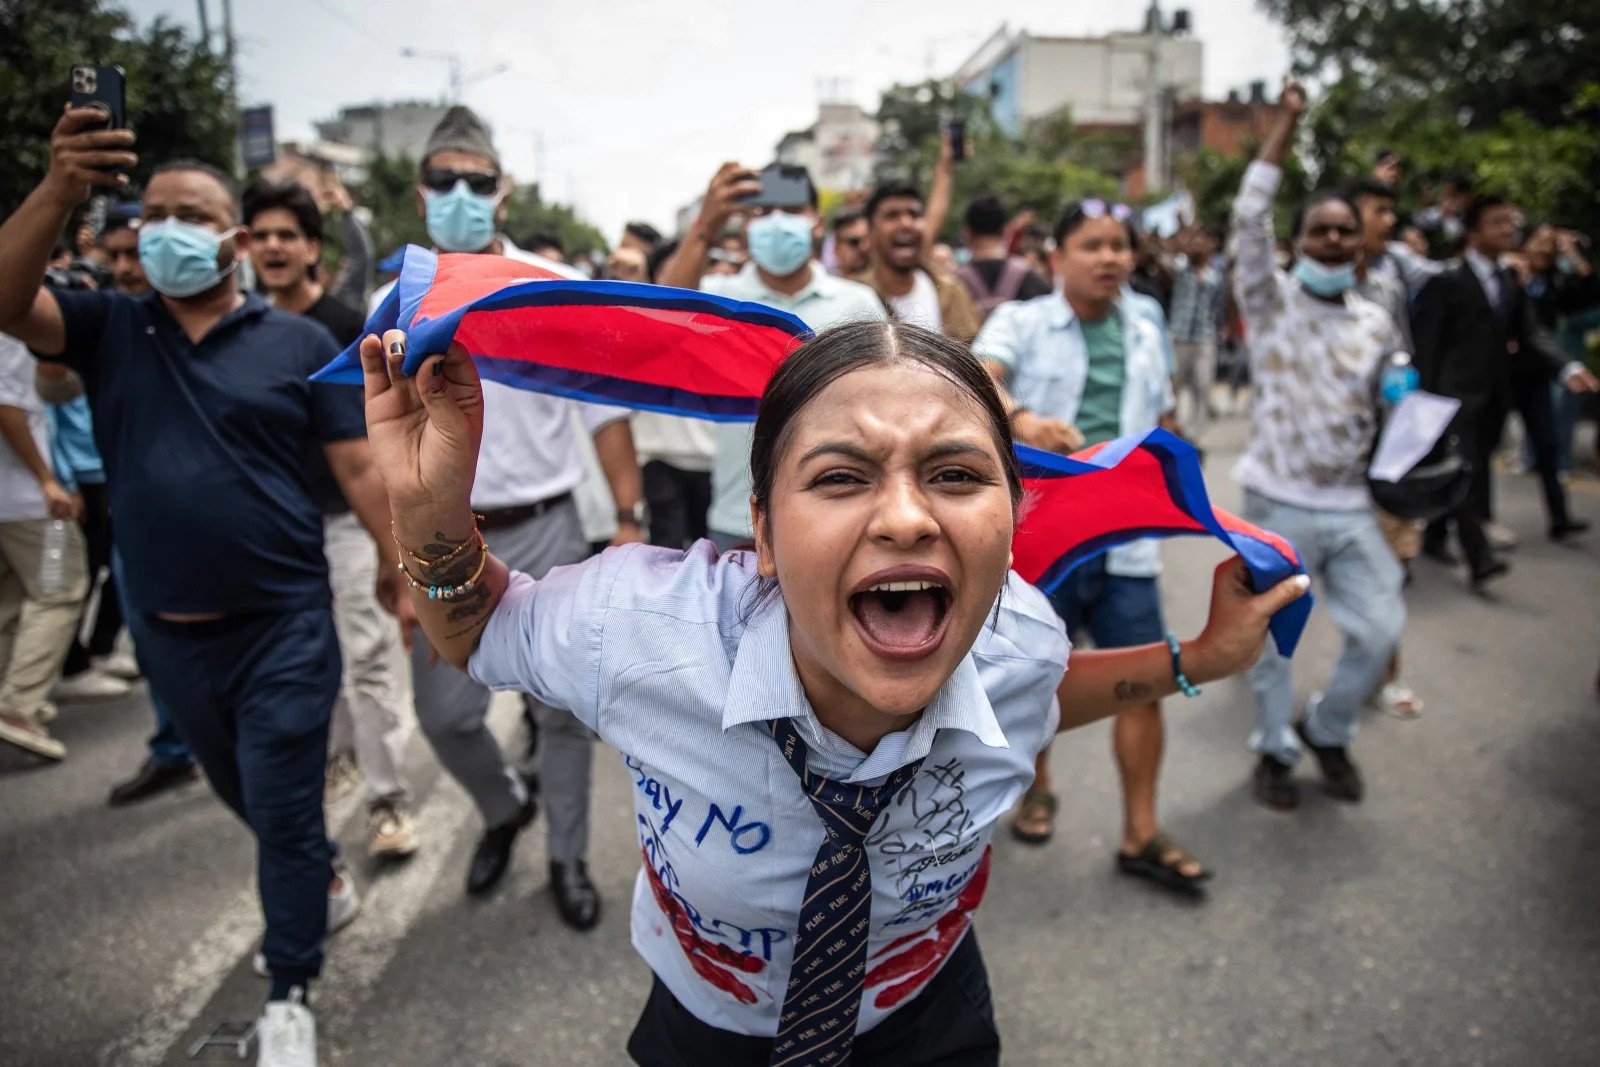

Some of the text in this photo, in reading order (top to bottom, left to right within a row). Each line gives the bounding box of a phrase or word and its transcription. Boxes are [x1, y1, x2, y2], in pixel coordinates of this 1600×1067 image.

[784, 734, 796, 759] PLMC
[811, 850, 848, 877] PLMC PLMC
[805, 868, 869, 931] PLMC PLMC PLMC
[803, 957, 823, 975] PLMC
[826, 939, 847, 956] PLMC
[849, 917, 869, 937] PLMC
[823, 980, 844, 995] PLMC
